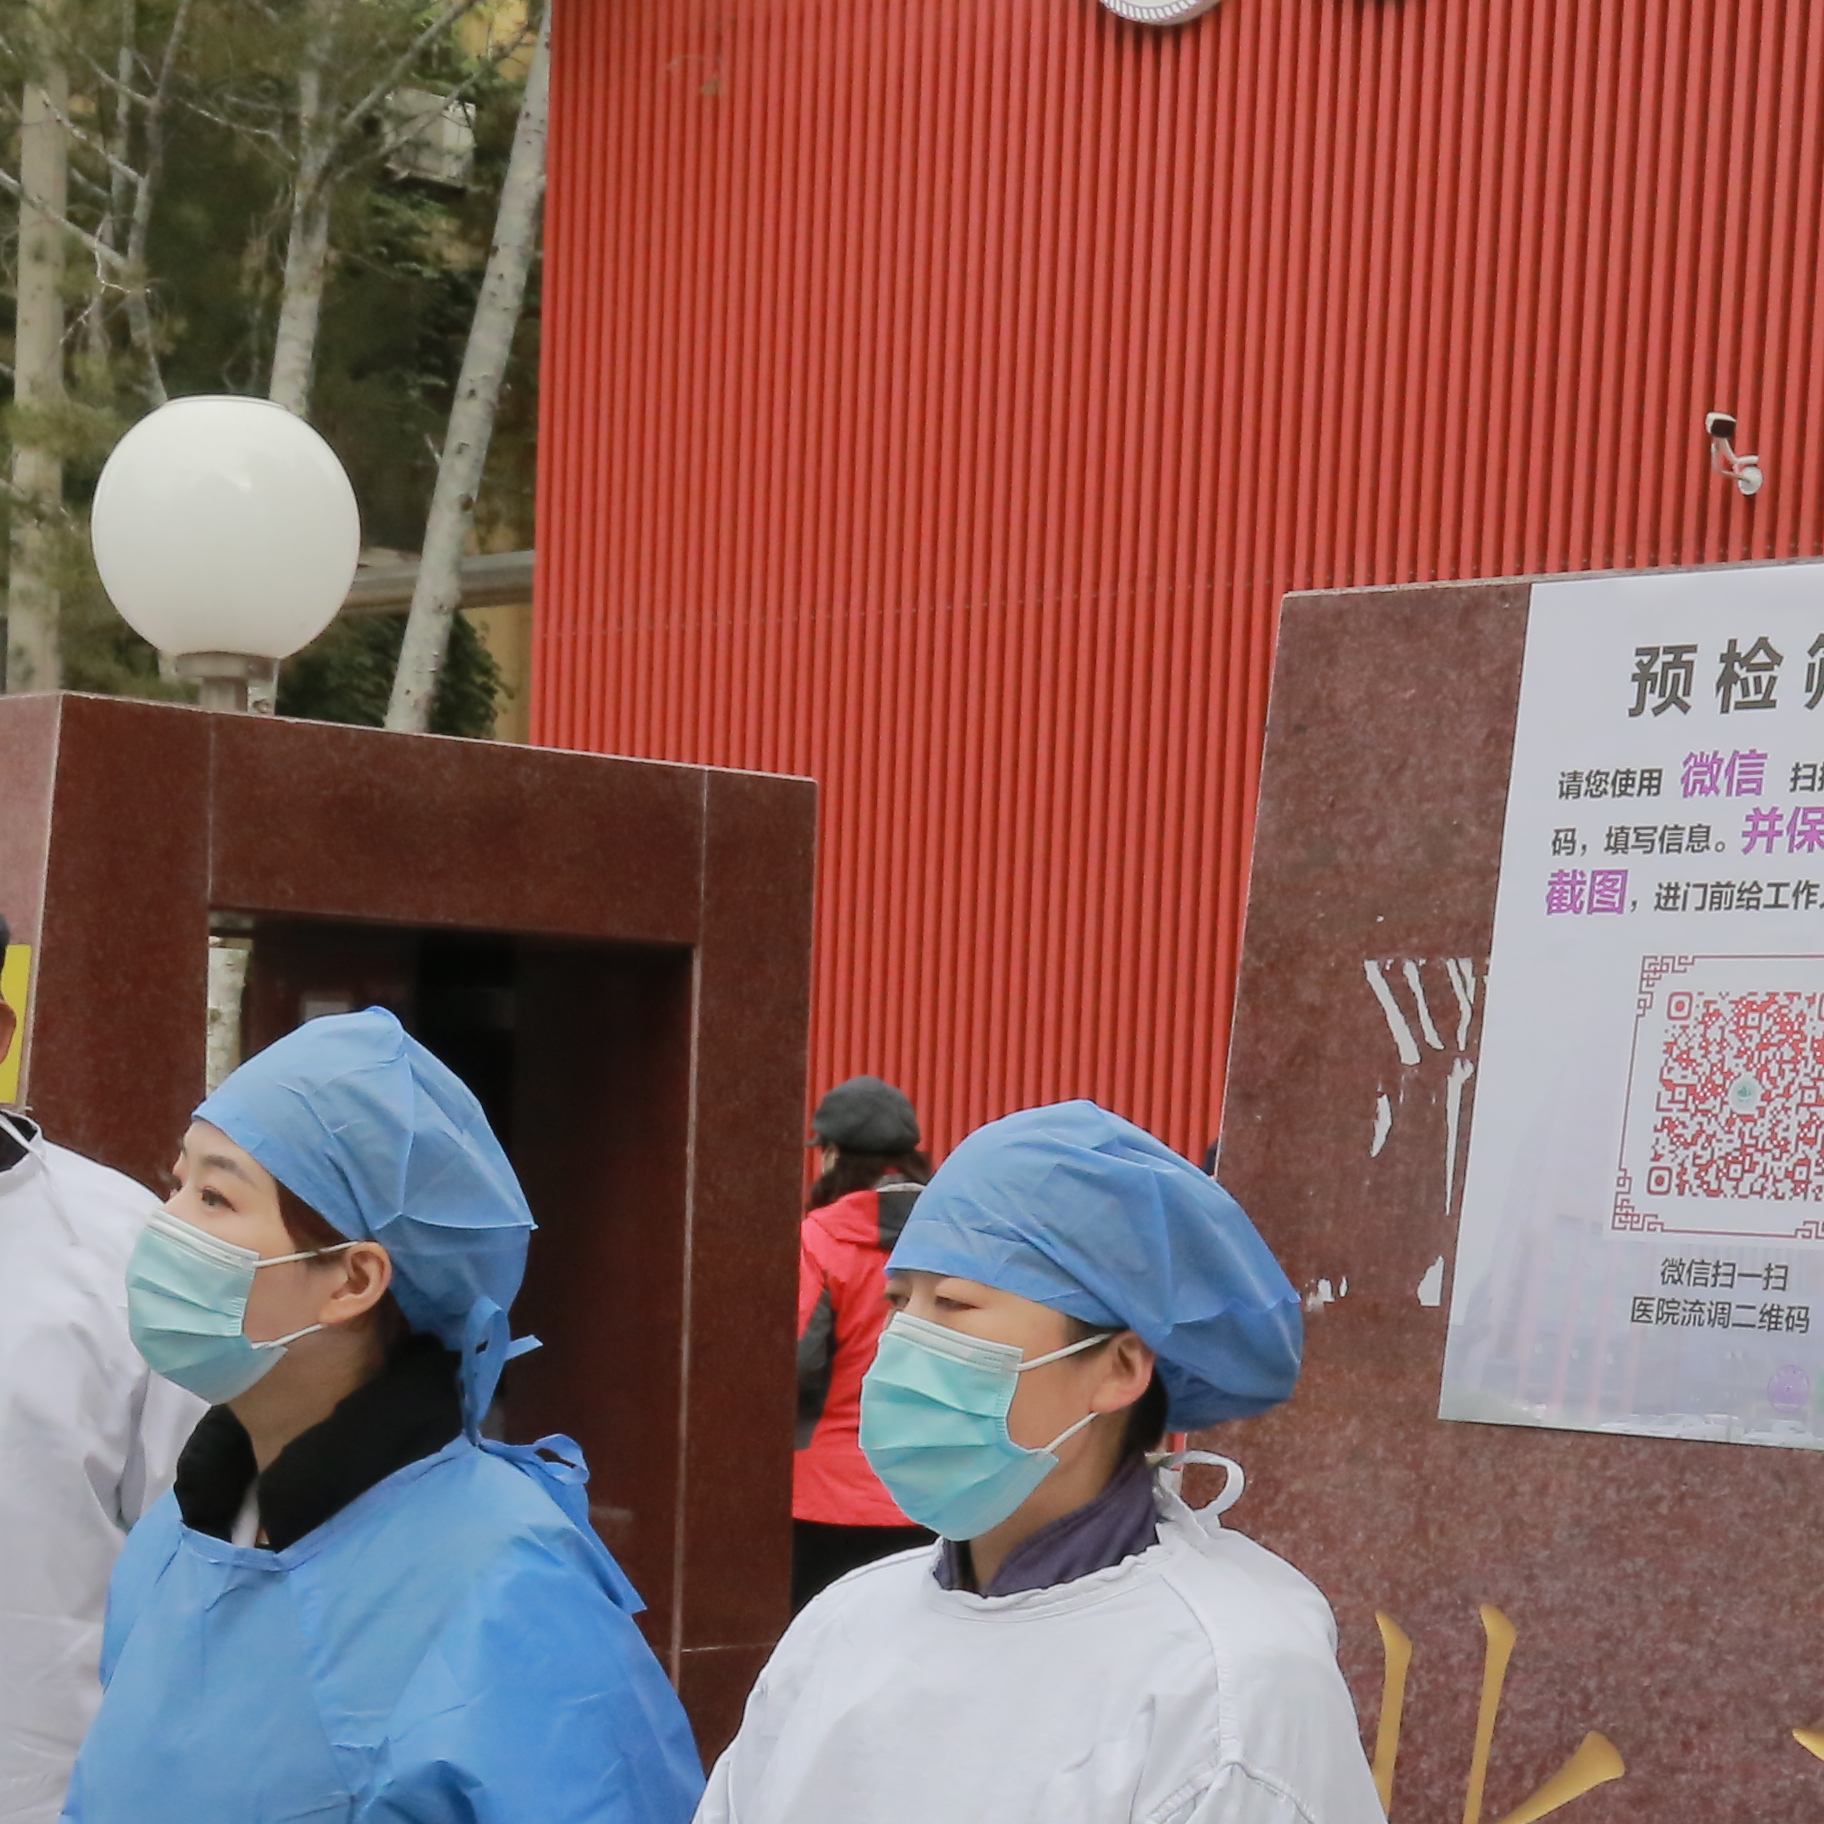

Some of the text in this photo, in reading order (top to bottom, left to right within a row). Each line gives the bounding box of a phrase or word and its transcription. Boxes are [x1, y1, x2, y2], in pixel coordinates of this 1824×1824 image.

[1558, 766, 1662, 800] 请您使用
[1680, 750, 1768, 797] 微信
[1660, 1258, 1789, 1291] 微信扫一扫
[1630, 1297, 1811, 1335] 医院流调二维码
